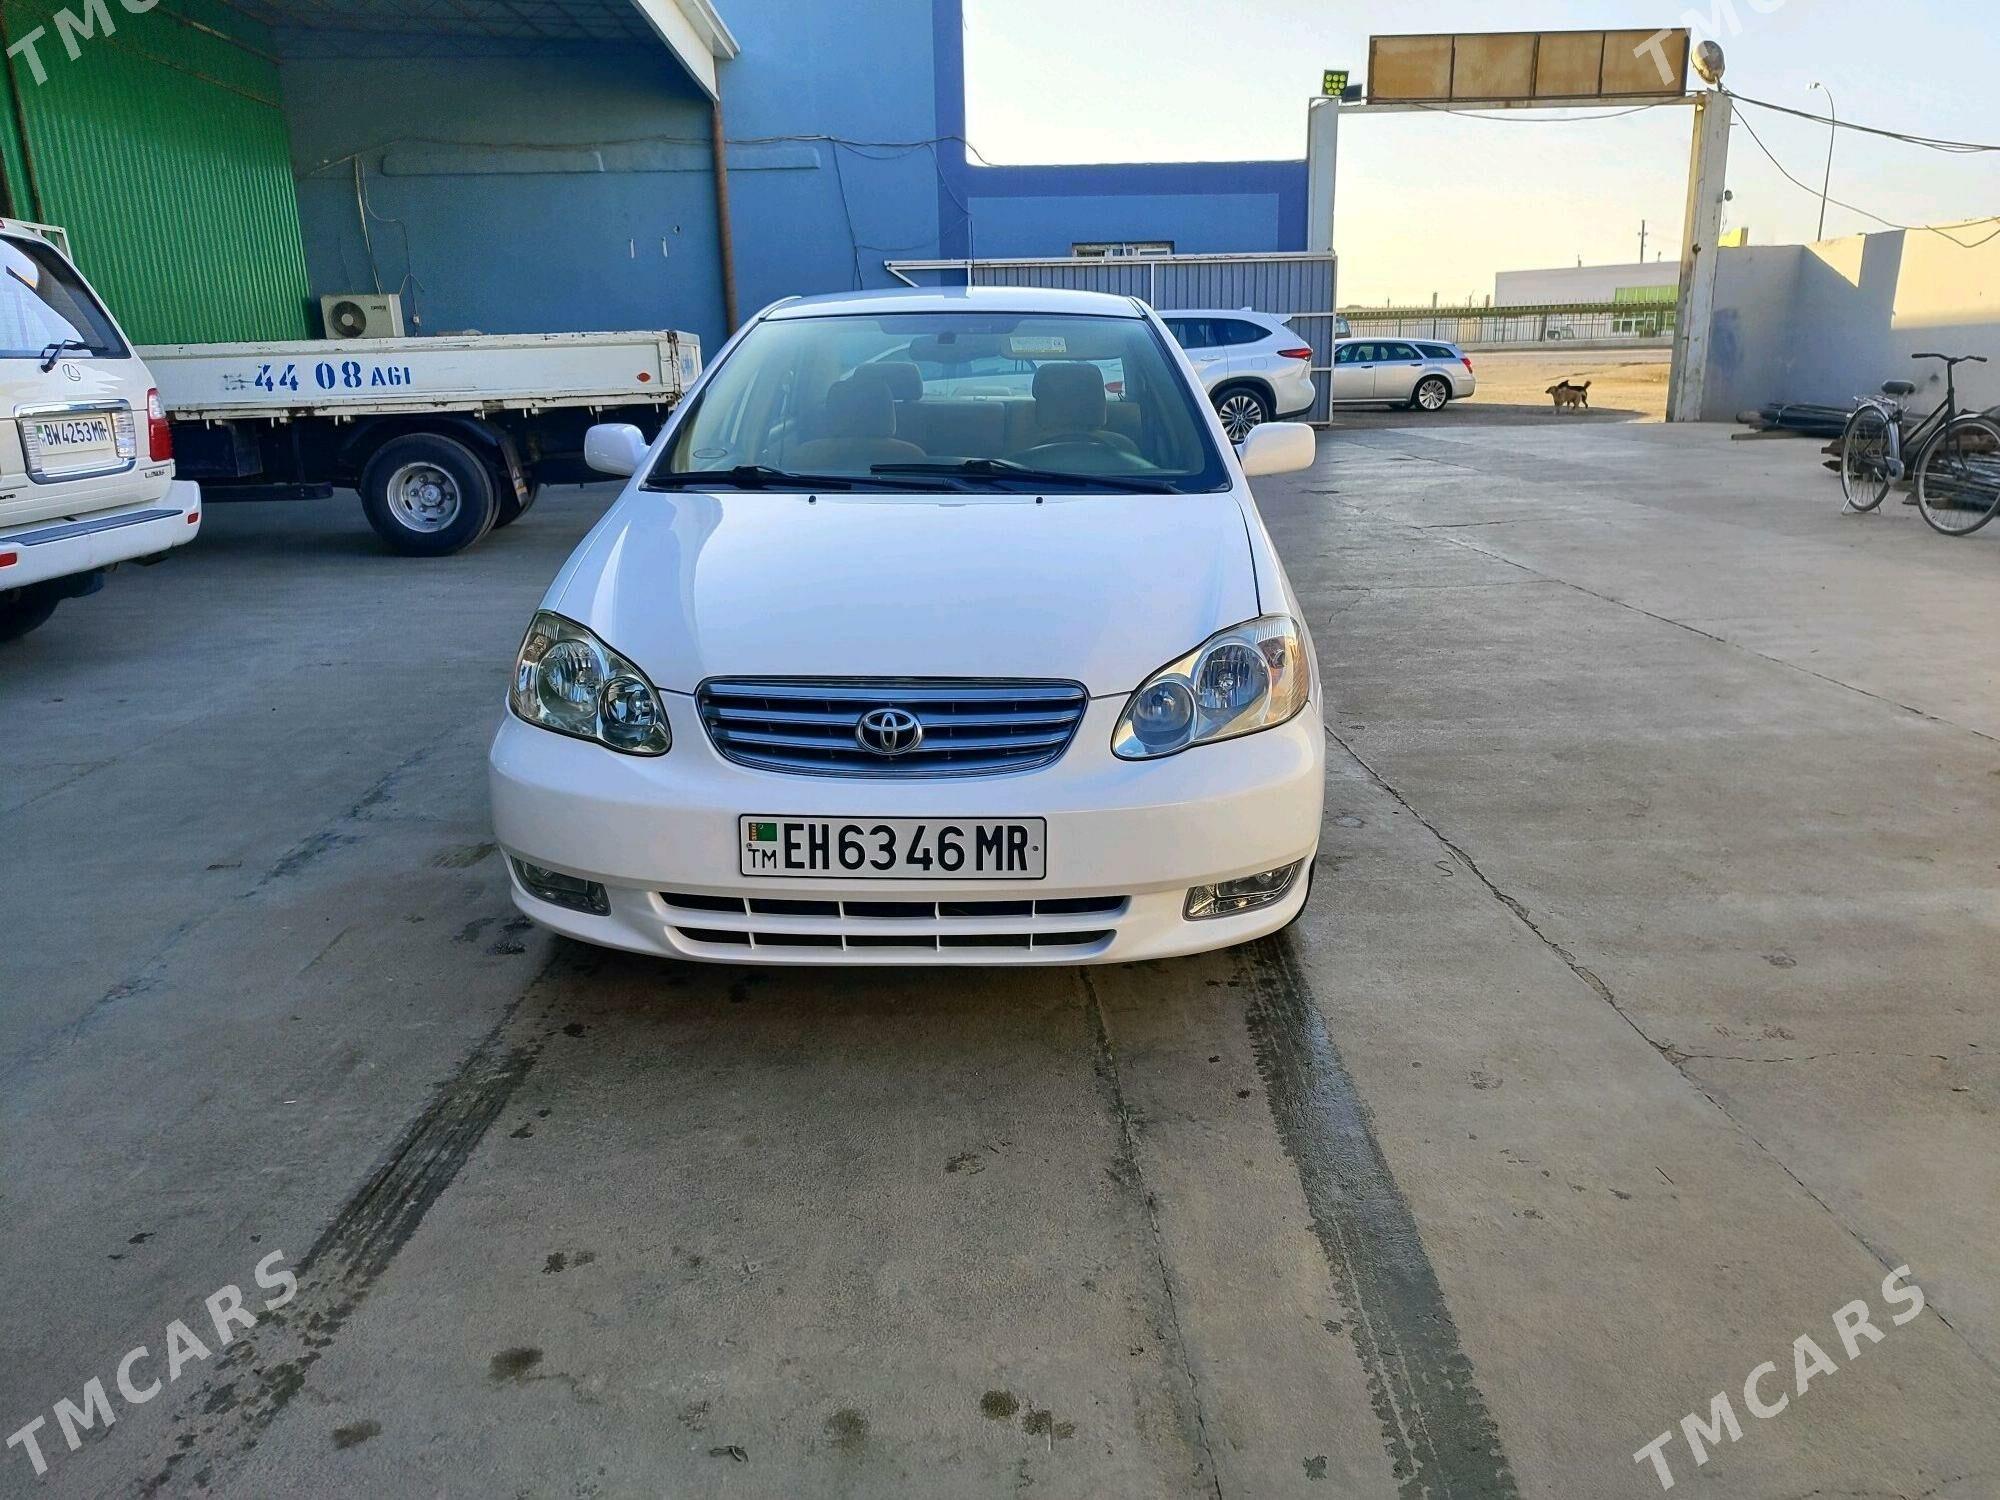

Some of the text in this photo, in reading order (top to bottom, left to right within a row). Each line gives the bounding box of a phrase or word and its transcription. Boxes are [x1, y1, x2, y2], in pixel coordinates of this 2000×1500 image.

[254, 364, 299, 392] 44
[315, 361, 362, 390] 08
[748, 848, 777, 869] TM
